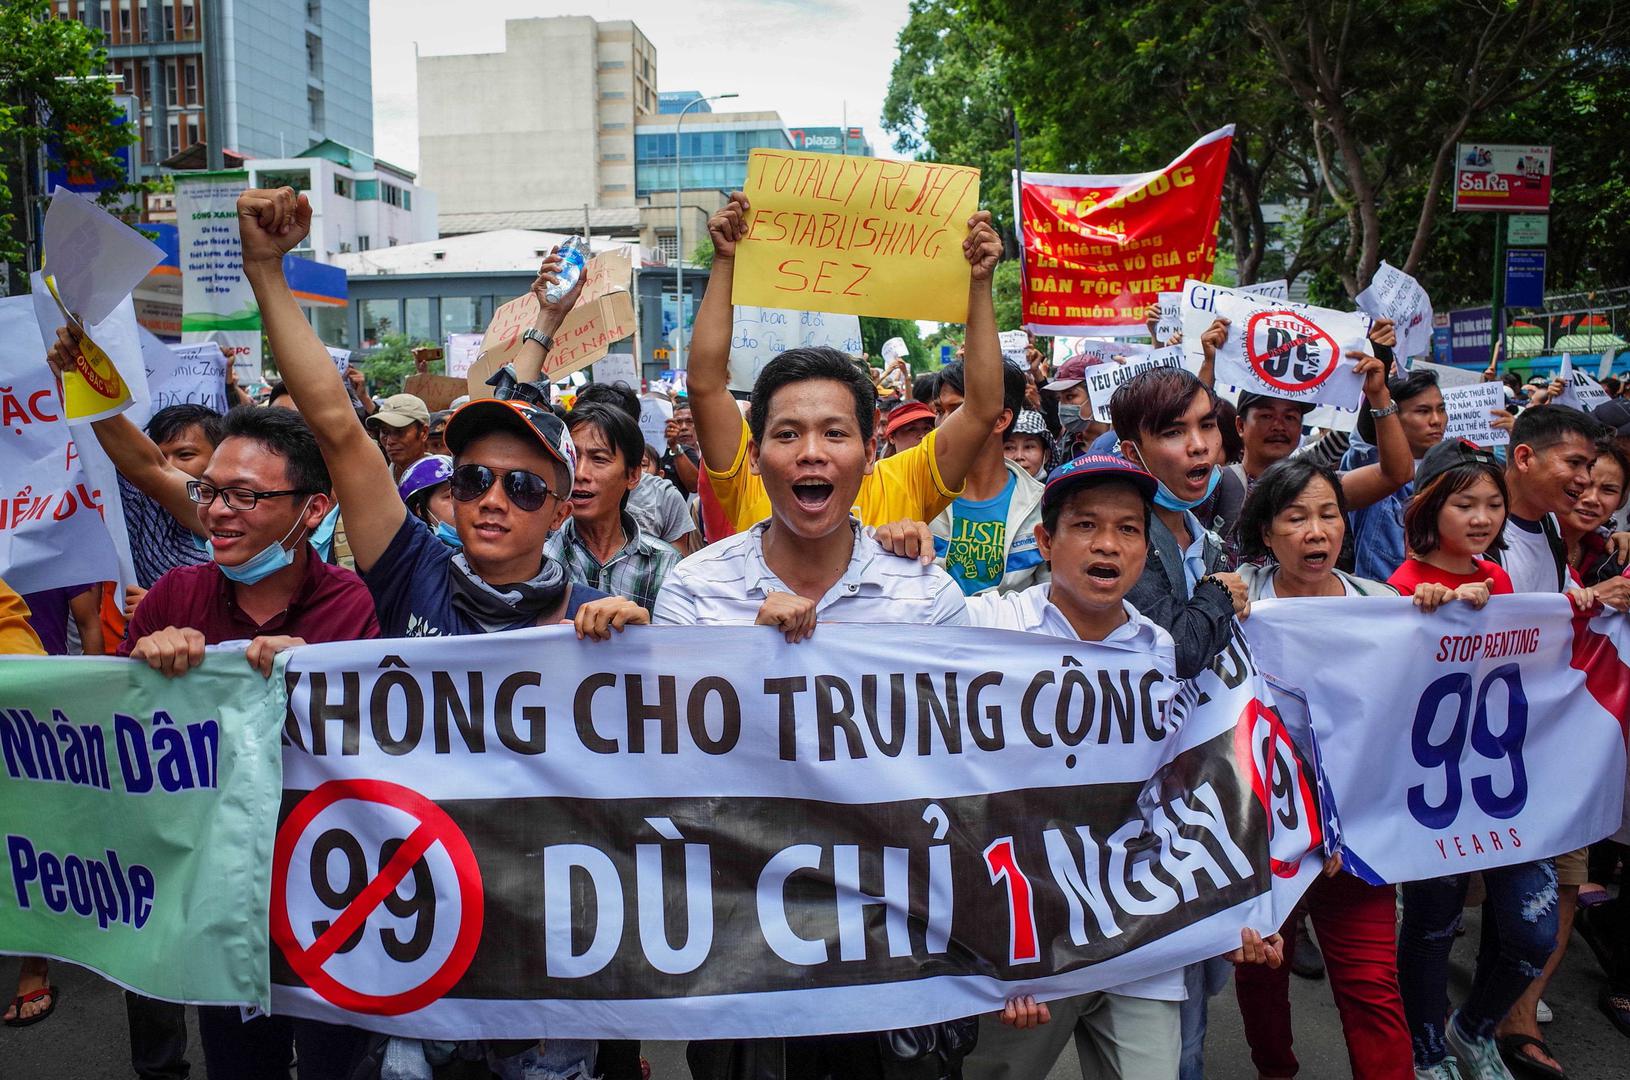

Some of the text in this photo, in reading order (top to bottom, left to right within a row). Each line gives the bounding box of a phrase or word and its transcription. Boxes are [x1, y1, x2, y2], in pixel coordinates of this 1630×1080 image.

[754, 153, 981, 226] TOTALLY REJECT
[1460, 172, 1509, 191] SaRa
[746, 210, 948, 260] ESTABLISHING
[1031, 275, 1073, 293] DÂN
[1080, 277, 1122, 298] TỘC
[1029, 300, 1060, 317] đến
[1065, 304, 1115, 319] muôn
[1090, 370, 1111, 392] YÊU
[1450, 389, 1468, 401] QUỐC
[1475, 400, 1483, 408] 10
[1453, 424, 1465, 432] LAI
[1468, 432, 1489, 442] TRUNG
[1436, 628, 1540, 663] STOP RENTING
[573, 672, 741, 756] CHO
[763, 671, 1006, 762] TRUNG
[1020, 655, 1168, 769] CỘNG
[0, 707, 220, 795] Nhân Dân
[1407, 662, 1529, 830] 99
[1435, 828, 1522, 860] YEARS
[5, 834, 156, 931] People
[310, 828, 437, 963] 99
[543, 781, 1255, 979] DÙ CHỈ 1 NGÀY
